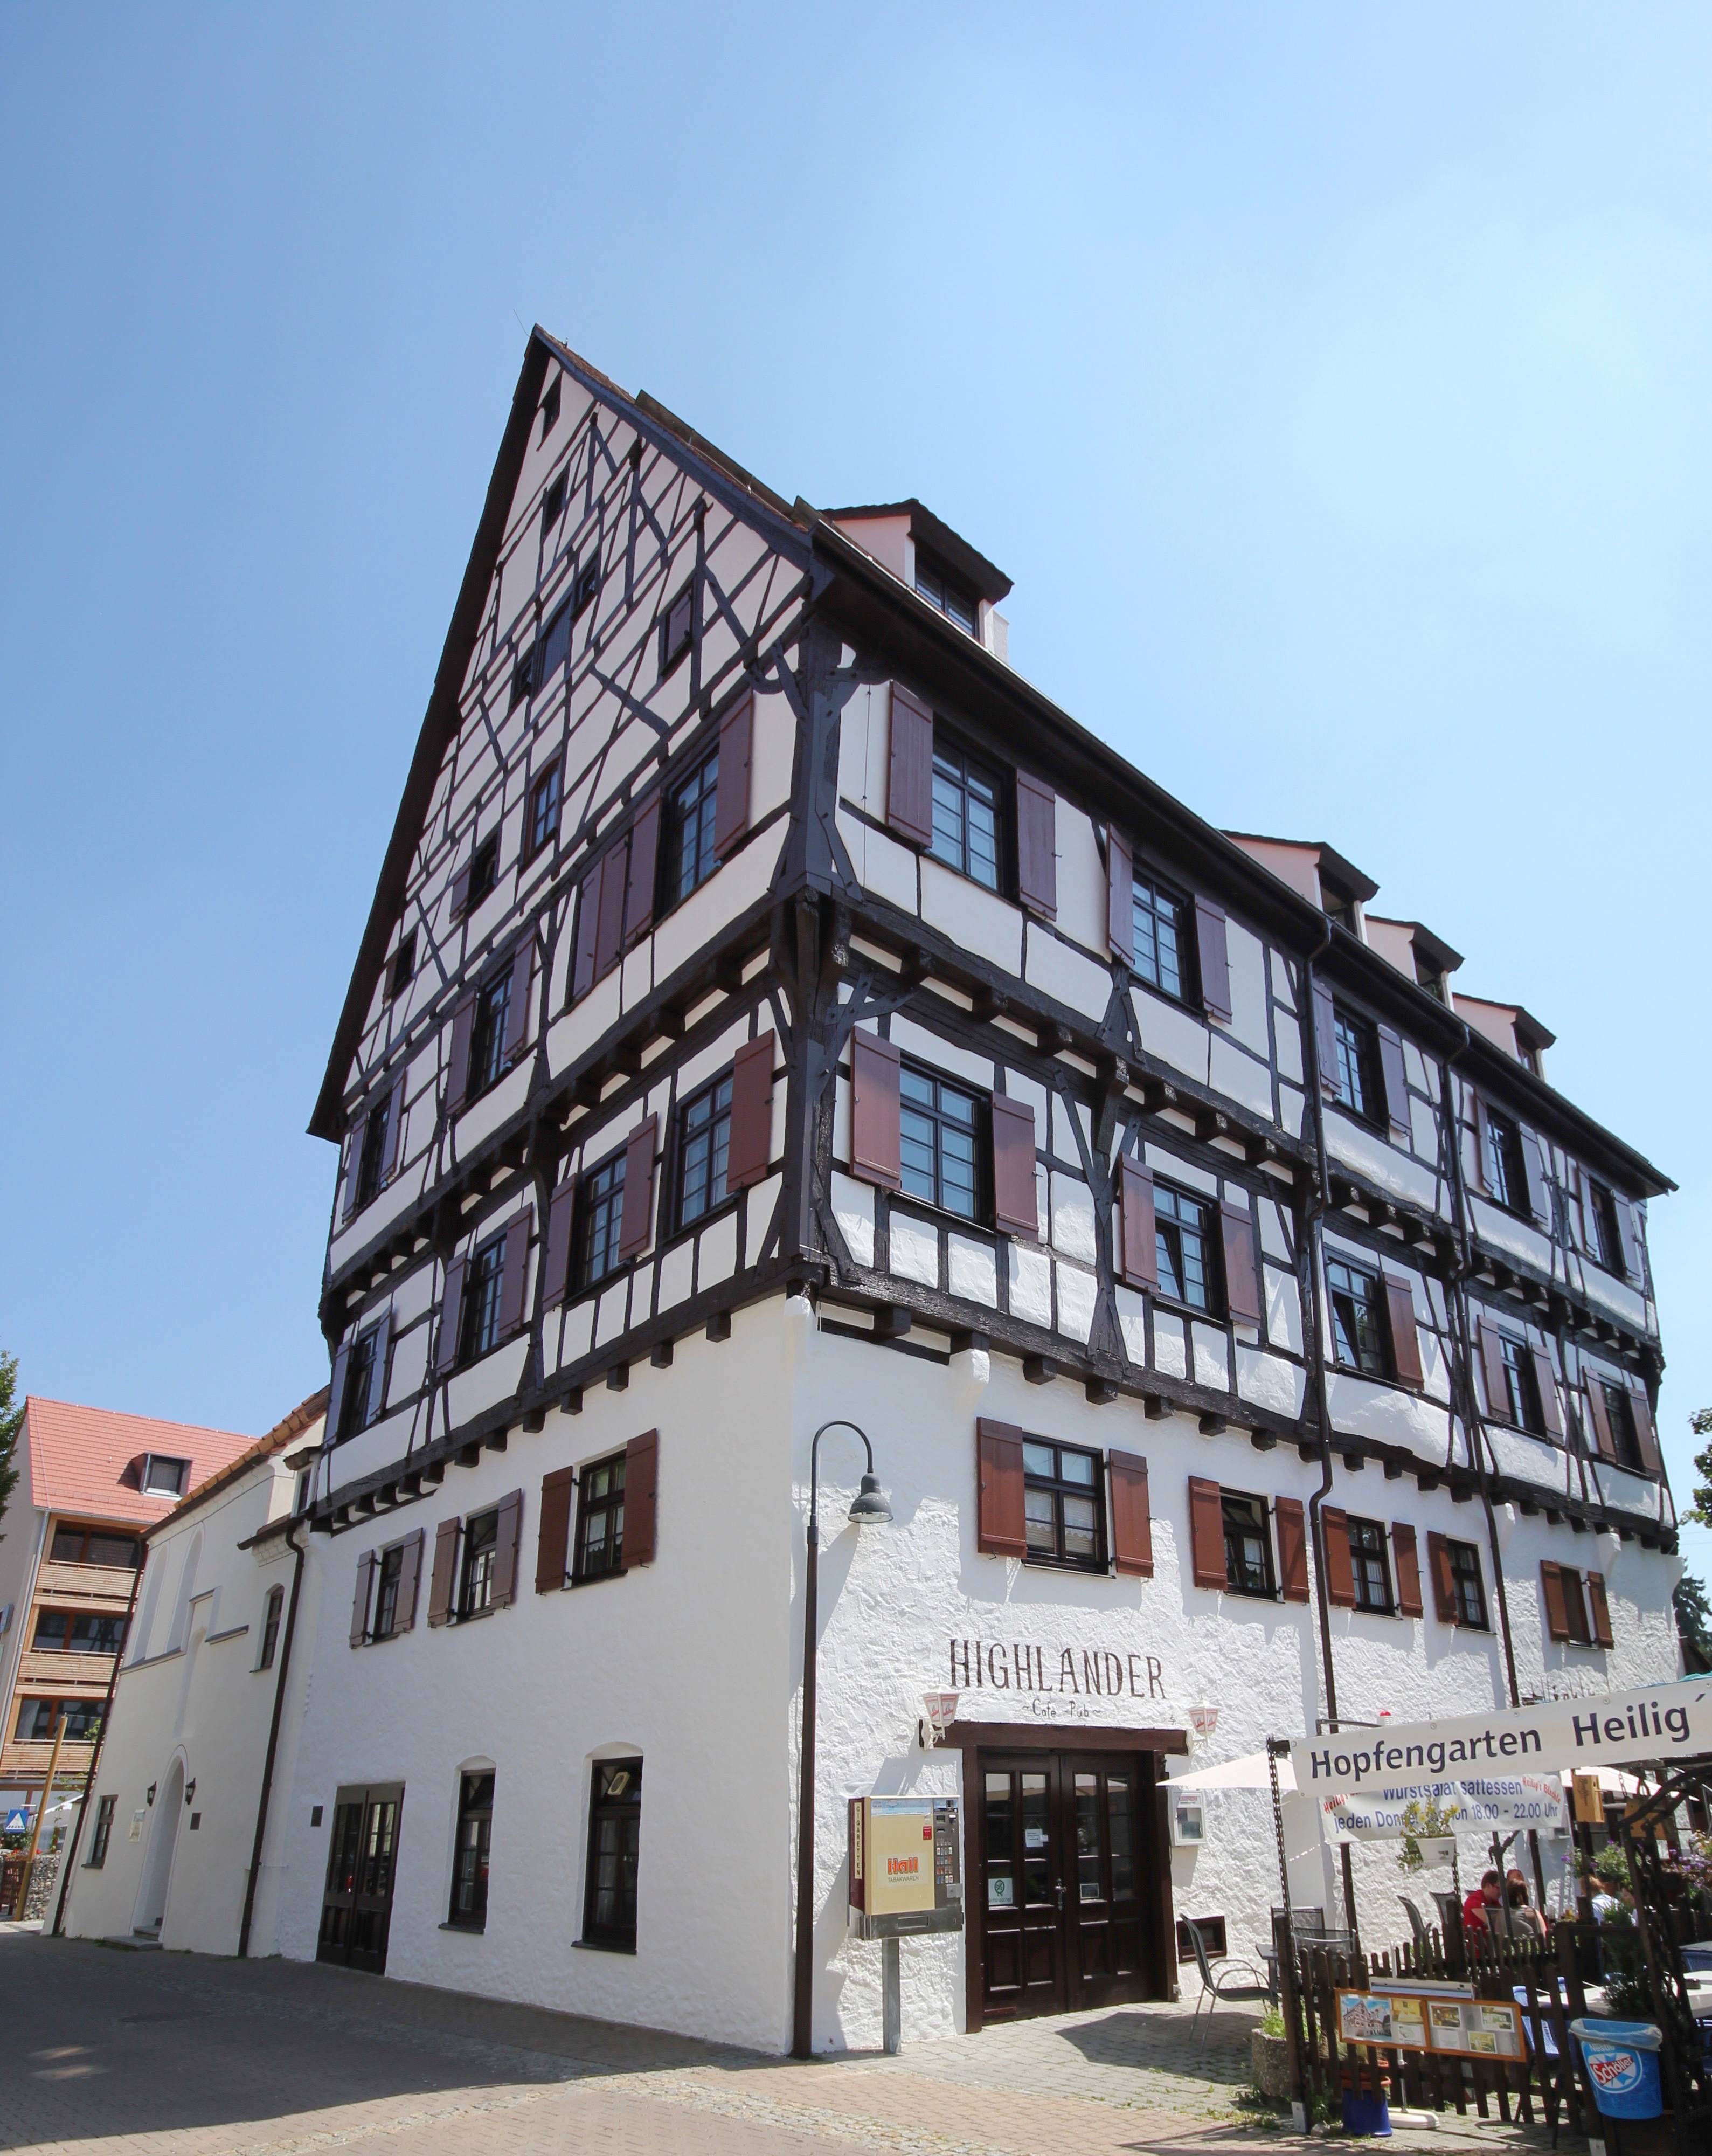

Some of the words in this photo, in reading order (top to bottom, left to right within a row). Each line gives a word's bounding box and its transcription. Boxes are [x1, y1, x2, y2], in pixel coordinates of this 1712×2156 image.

[949, 1639, 1166, 1698] HIGHLANDER
[1311, 1729, 1542, 1781] Hopfengarten
[1383, 1781, 1457, 1800] Wurstsalat
[1460, 1779, 1522, 1795] sattessen
[1334, 1813, 1371, 1833] jeden
[1472, 1803, 1499, 1820] 18.00
[1514, 1802, 1541, 1819] 22.00
[1544, 1802, 1558, 1817] Uhr
[888, 1857, 919, 1875] Hall
[1592, 2057, 1633, 2084] Schöller
